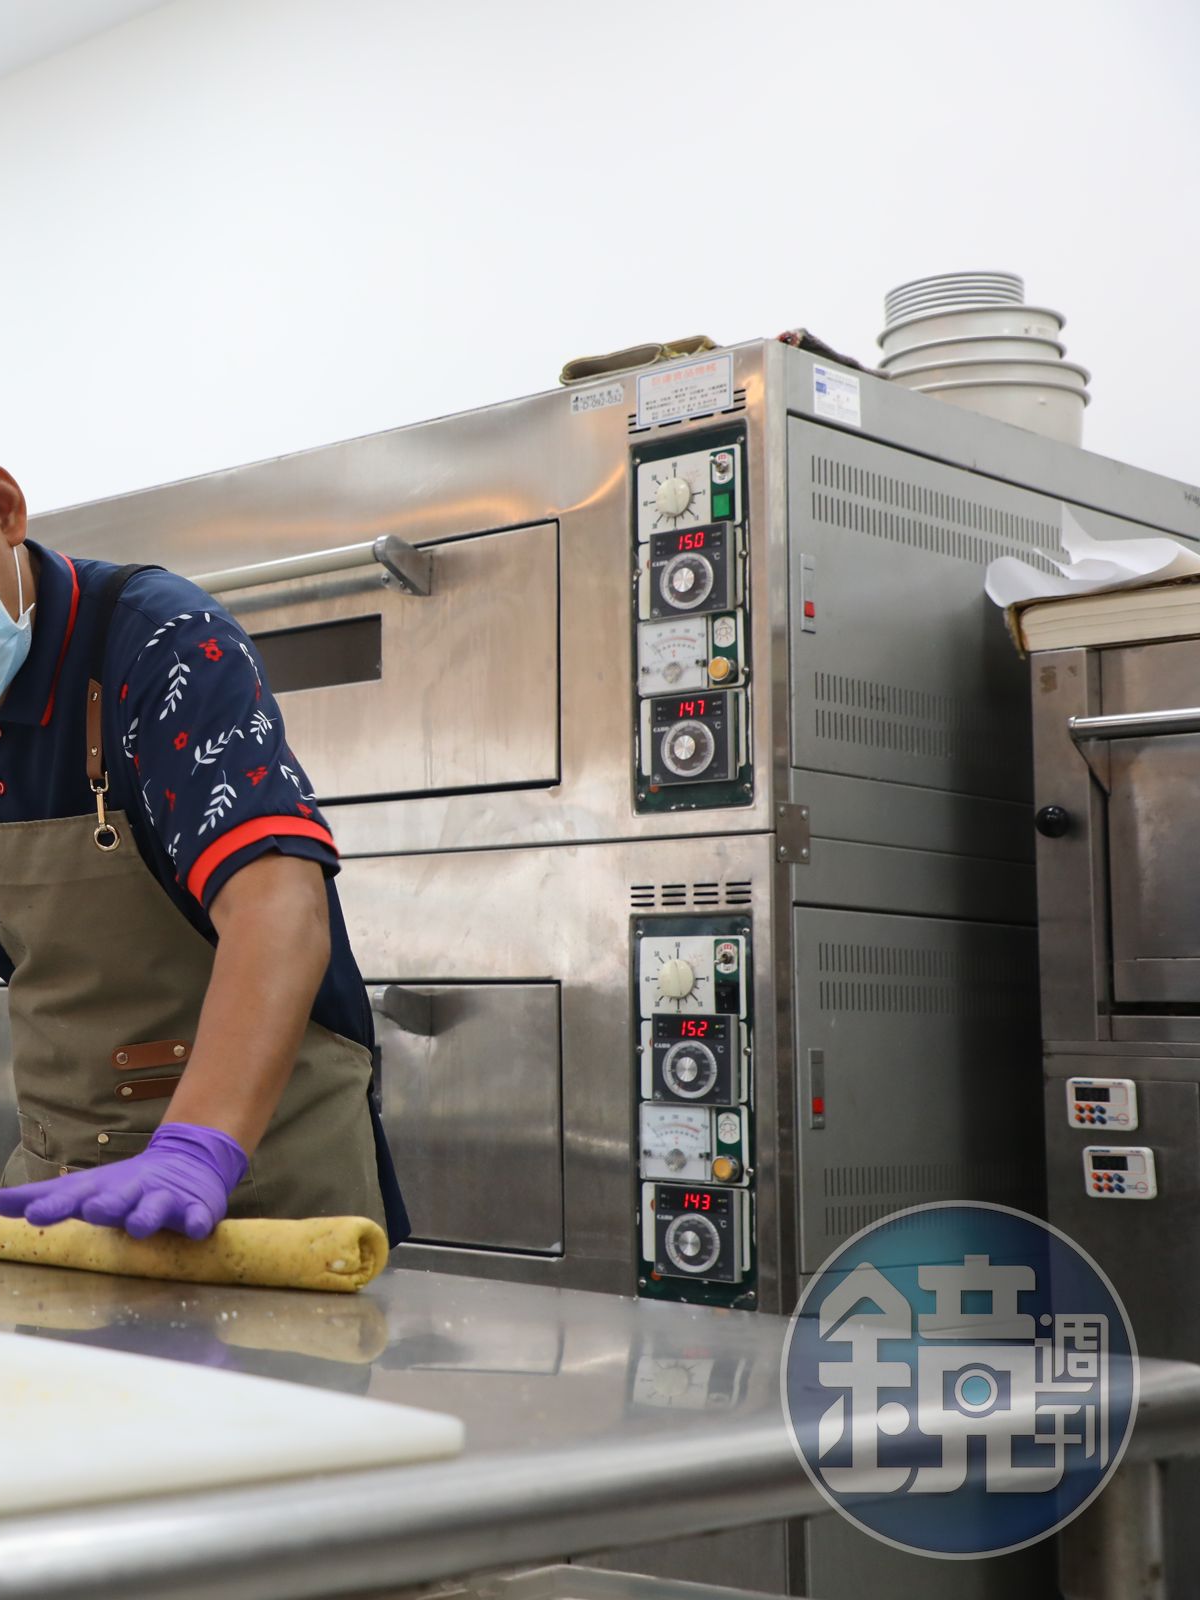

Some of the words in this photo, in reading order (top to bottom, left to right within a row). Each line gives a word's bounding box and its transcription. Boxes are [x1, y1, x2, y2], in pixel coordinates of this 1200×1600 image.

[678, 531, 705, 551] 150
[679, 699, 705, 718] 147
[681, 1020, 709, 1037] 152
[684, 1192, 711, 1210] 143
